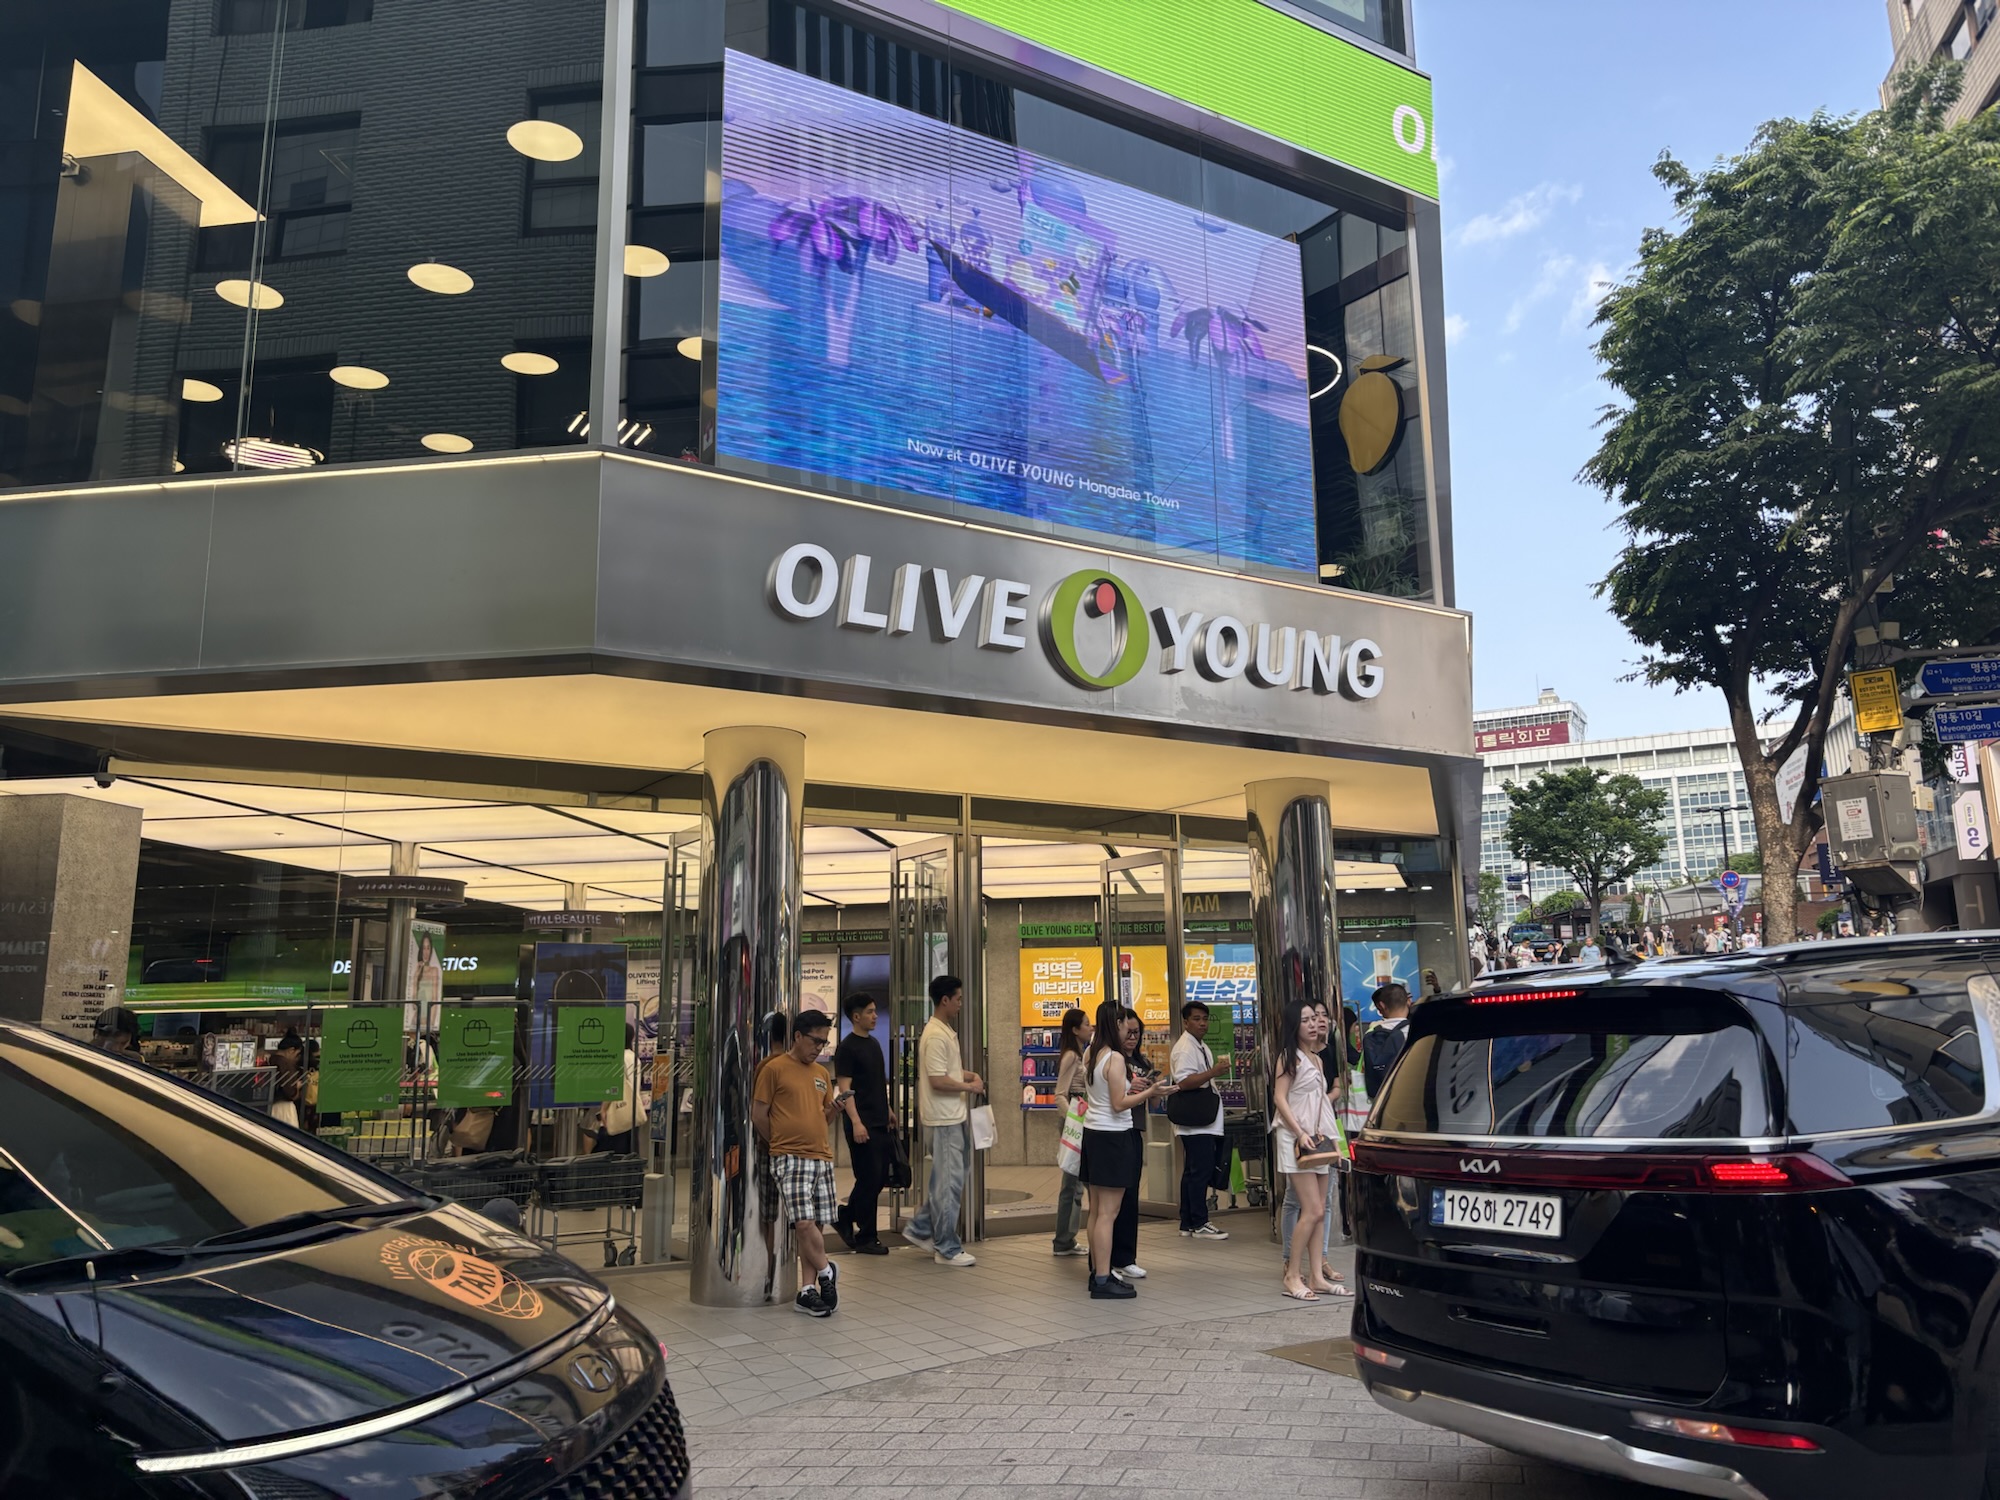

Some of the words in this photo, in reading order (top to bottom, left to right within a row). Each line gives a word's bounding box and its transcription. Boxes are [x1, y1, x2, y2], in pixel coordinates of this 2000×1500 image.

[907, 437, 943, 459] Now
[946, 449, 962, 463] at
[969, 452, 1016, 475] OLIVE
[1022, 462, 1075, 488] YOUNG
[1078, 476, 1141, 501] Hongdae
[1143, 491, 1180, 510] Town
[771, 542, 1031, 652] OLIVE
[1153, 605, 1384, 700] YOUNG
[1941, 675, 1990, 685] Myeongdong
[1937, 710, 1983, 724] 명동10길
[1939, 723, 1991, 733] Myeongdong
[1967, 827, 1981, 848] CU
[1021, 926, 1043, 936] OLIVE
[1045, 925, 1072, 935] YOUNG
[1074, 924, 1093, 934] PICK
[1134, 923, 1152, 933] BEST
[1343, 919, 1358, 927] THE
[1360, 918, 1380, 926] BEST
[1033, 961, 1083, 980] 면역은
[1033, 980, 1095, 995] 에브리타임
[1448, 1193, 1496, 1224] 196하
[1503, 1198, 1555, 1230] 2749
[379, 1233, 477, 1280] International
[448, 1260, 497, 1300] TAXI
